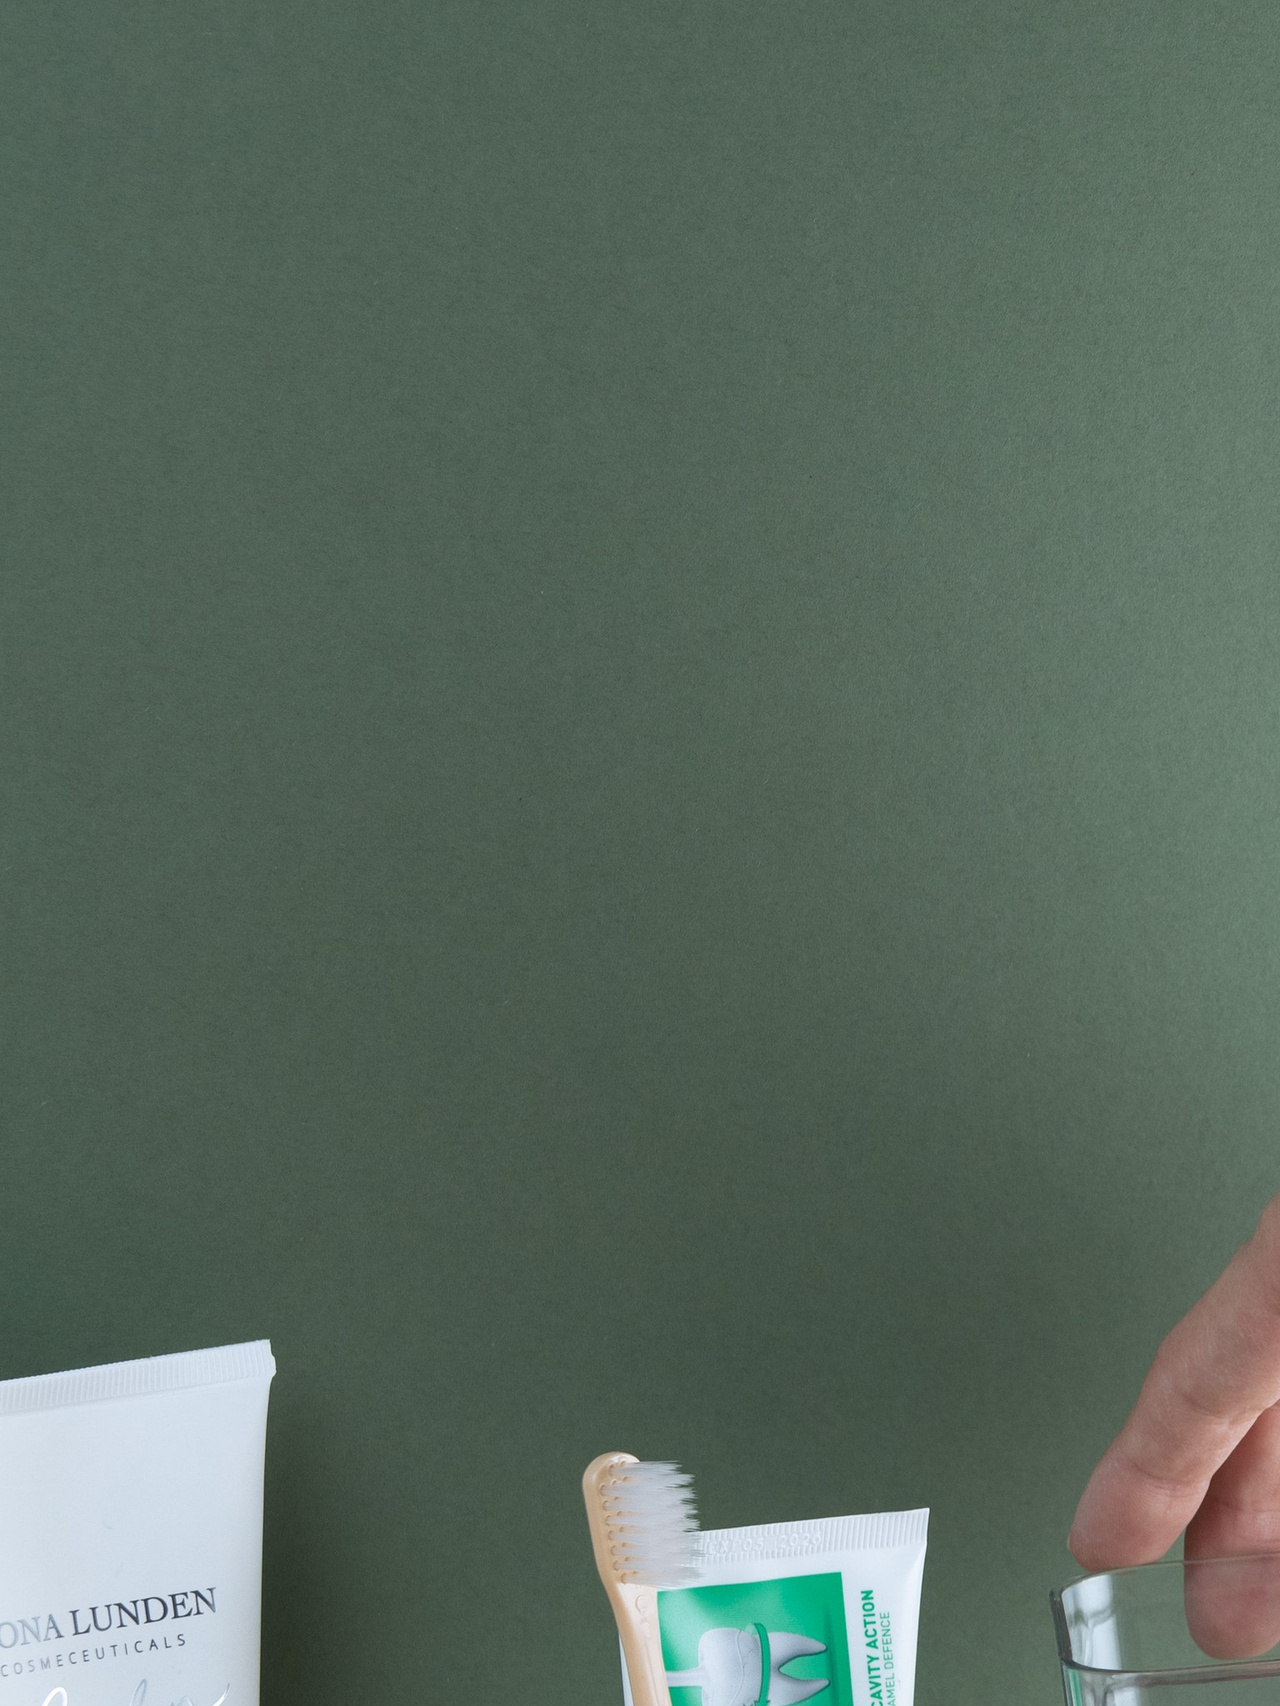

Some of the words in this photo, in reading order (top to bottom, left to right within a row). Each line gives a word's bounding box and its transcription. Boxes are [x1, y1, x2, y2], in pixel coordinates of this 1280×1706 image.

[69, 1587, 216, 1636] LUNDEN
[860, 1589, 879, 1650] ACTION
[1, 1633, 186, 1677] COSMECEUTICALS
[880, 1611, 894, 1670] DEFENCE
